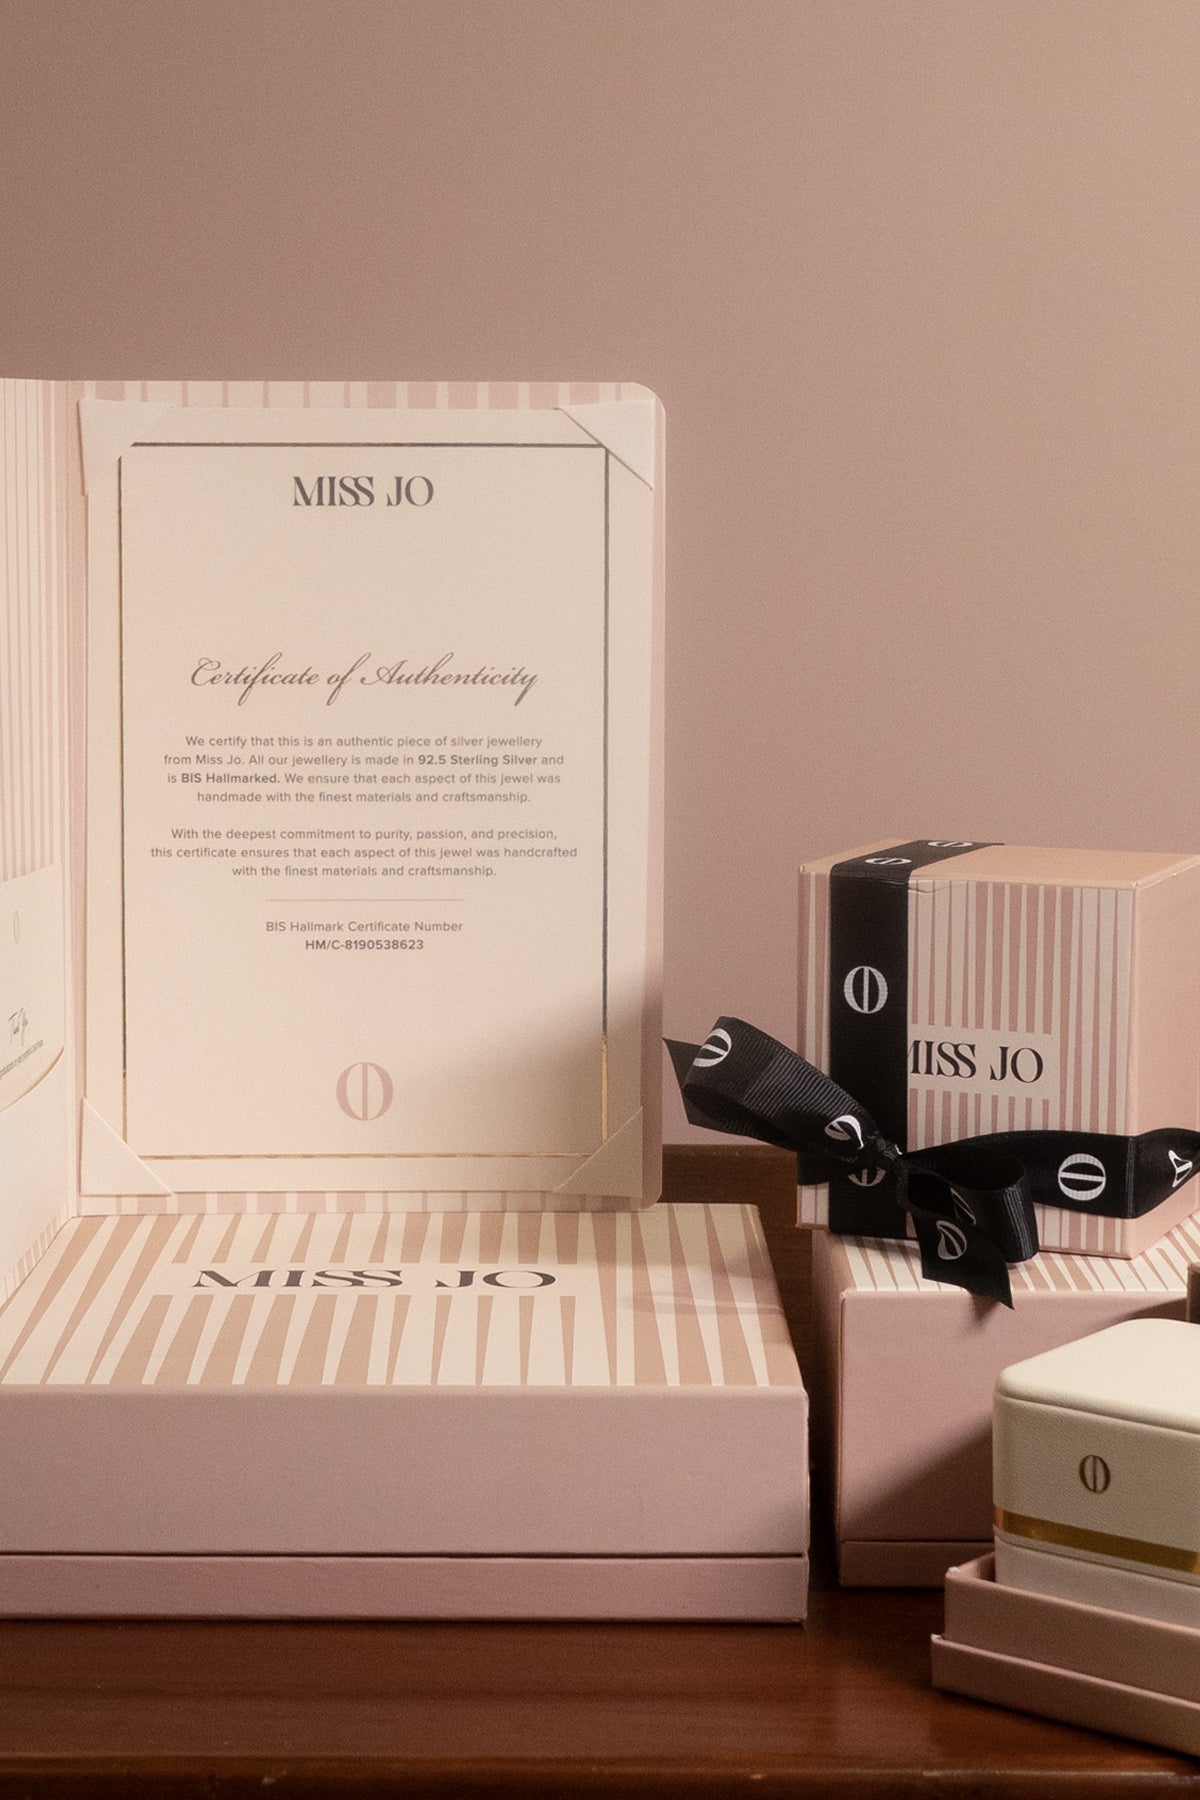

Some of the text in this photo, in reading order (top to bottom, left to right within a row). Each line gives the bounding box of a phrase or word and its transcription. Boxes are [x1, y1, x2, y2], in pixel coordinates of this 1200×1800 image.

[293, 476, 434, 506] MISS JO
[191, 652, 539, 706] Certificate of Authenticity
[184, 735, 543, 750] We certify that this is an authentic piece of silver jewellery
[163, 753, 565, 768] from Miss Jo. All our jewellery is made in 92.5 Sterling Silver and
[166, 771, 561, 787] is BIS Hallmarked. We ensure that each aspect of this jewel was
[196, 790, 531, 805] handmade with the finest materials and craftsmanship.
[170, 828, 558, 842] With the deepest commitment to purity, passion, and precision,
[150, 846, 578, 861] this certificate ensures that each aspect of this jewel was handcrafted
[231, 864, 497, 879] with the finest materials and craftsmanship.
[265, 920, 464, 933] BIS Hallmark Certificate Number
[304, 938, 425, 951] HM/C-8190538623
[990, 1046, 1044, 1083] JO
[192, 1269, 557, 1288] MISS JO
